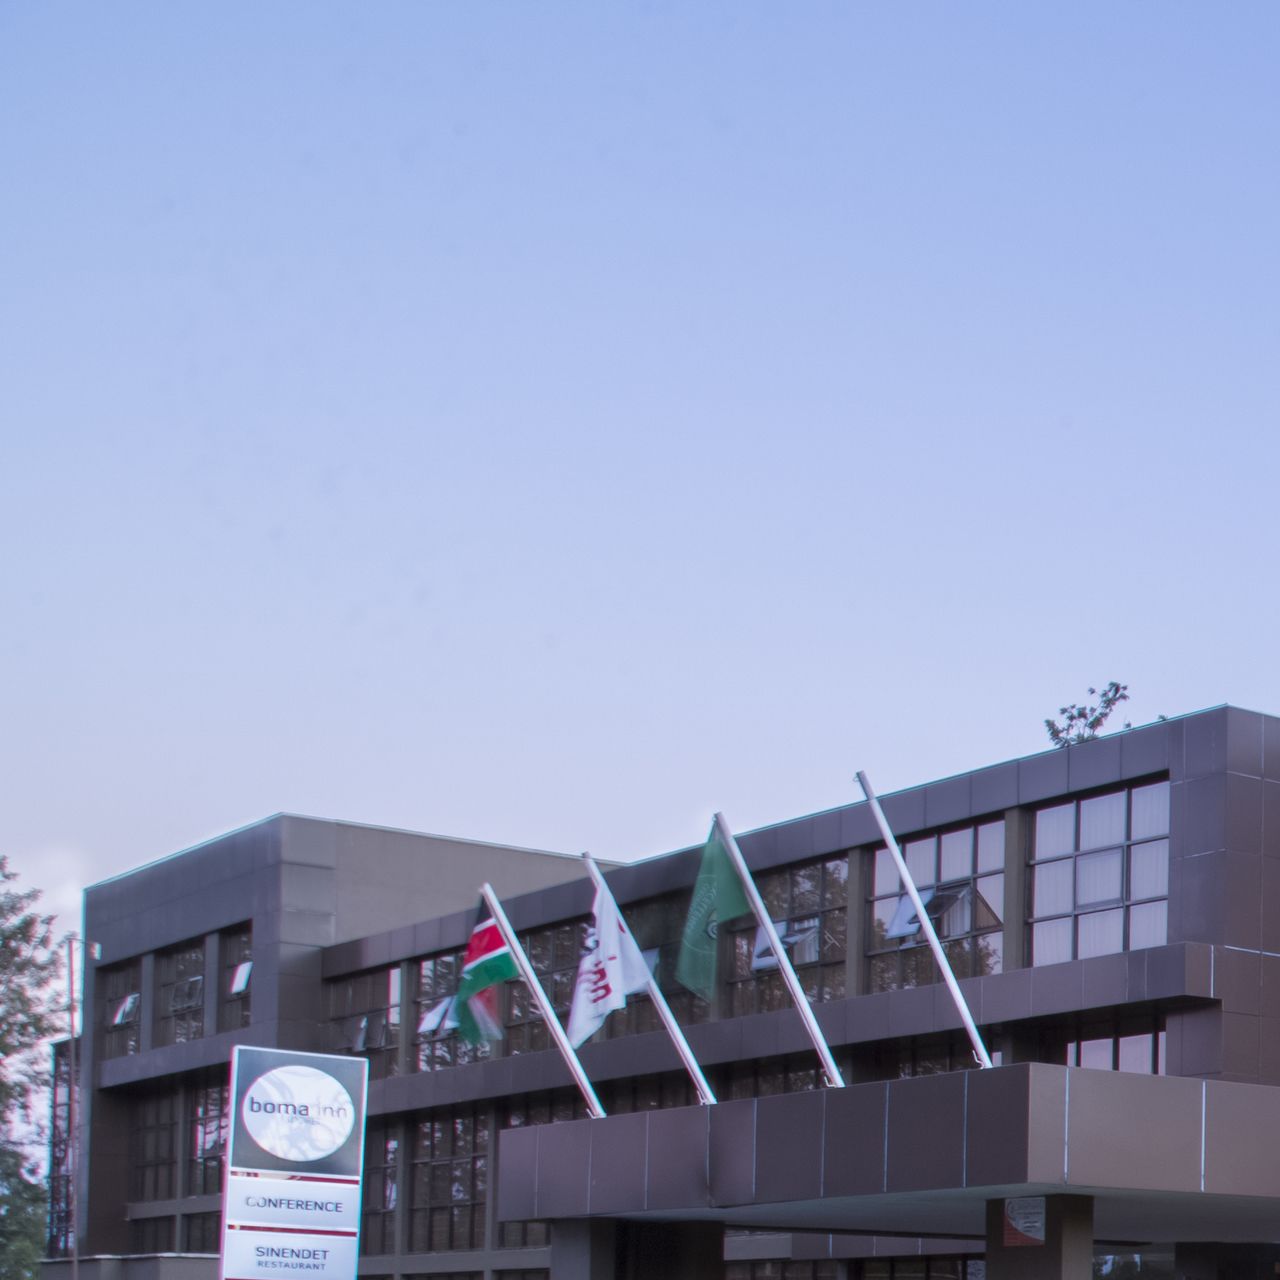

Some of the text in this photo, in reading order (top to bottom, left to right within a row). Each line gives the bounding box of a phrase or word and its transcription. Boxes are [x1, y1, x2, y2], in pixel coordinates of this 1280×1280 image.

[250, 1097, 309, 1116] boma
[245, 1196, 343, 1213] CONFERENCE
[255, 1246, 330, 1260] SINENDET
[257, 1260, 326, 1271] RESTAURANT
